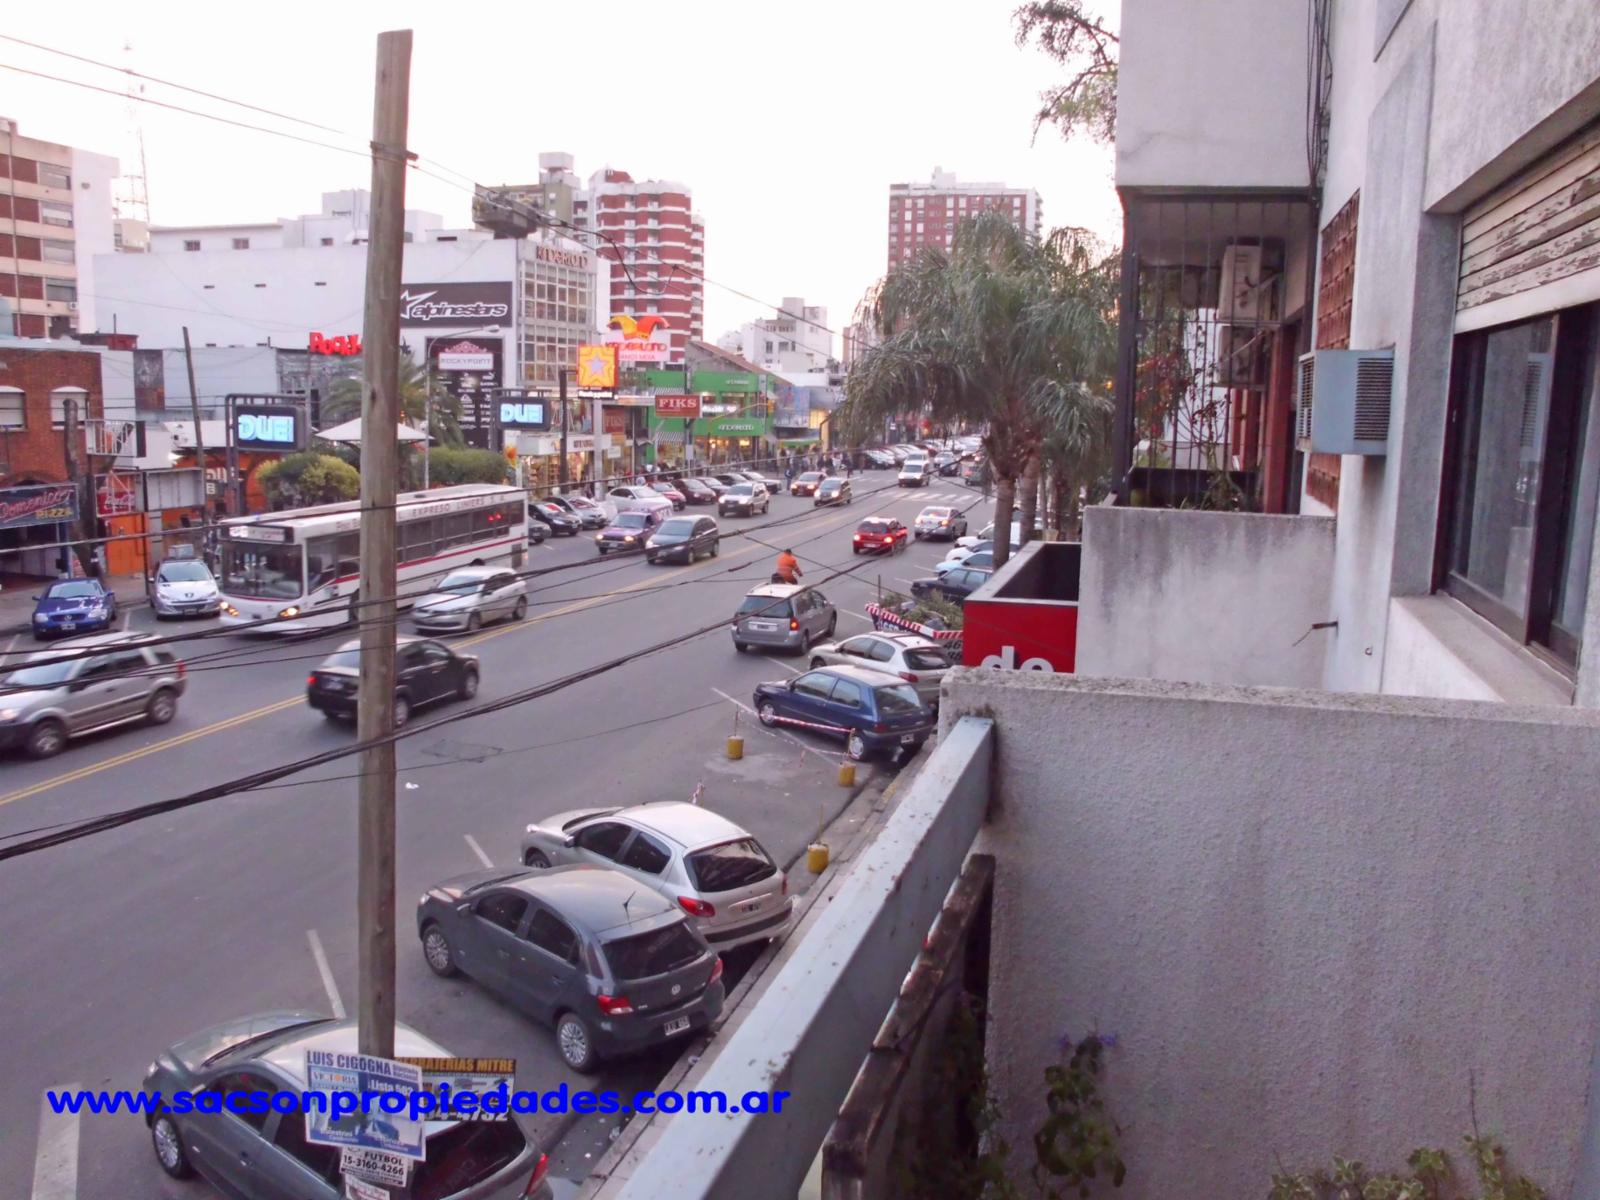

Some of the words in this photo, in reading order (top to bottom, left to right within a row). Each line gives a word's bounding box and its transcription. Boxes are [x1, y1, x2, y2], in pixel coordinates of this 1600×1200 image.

[411, 302, 508, 321] alpinestars
[659, 398, 697, 408] FIKS
[411, 503, 450, 518] EXPRESO
[307, 1050, 334, 1066] LUIS
[337, 1054, 392, 1076] CIGOGNA
[477, 1059, 514, 1072] MITRE
[343, 1154, 404, 1176] 15-3160-4266
[364, 1151, 404, 1166] FUTBOL
